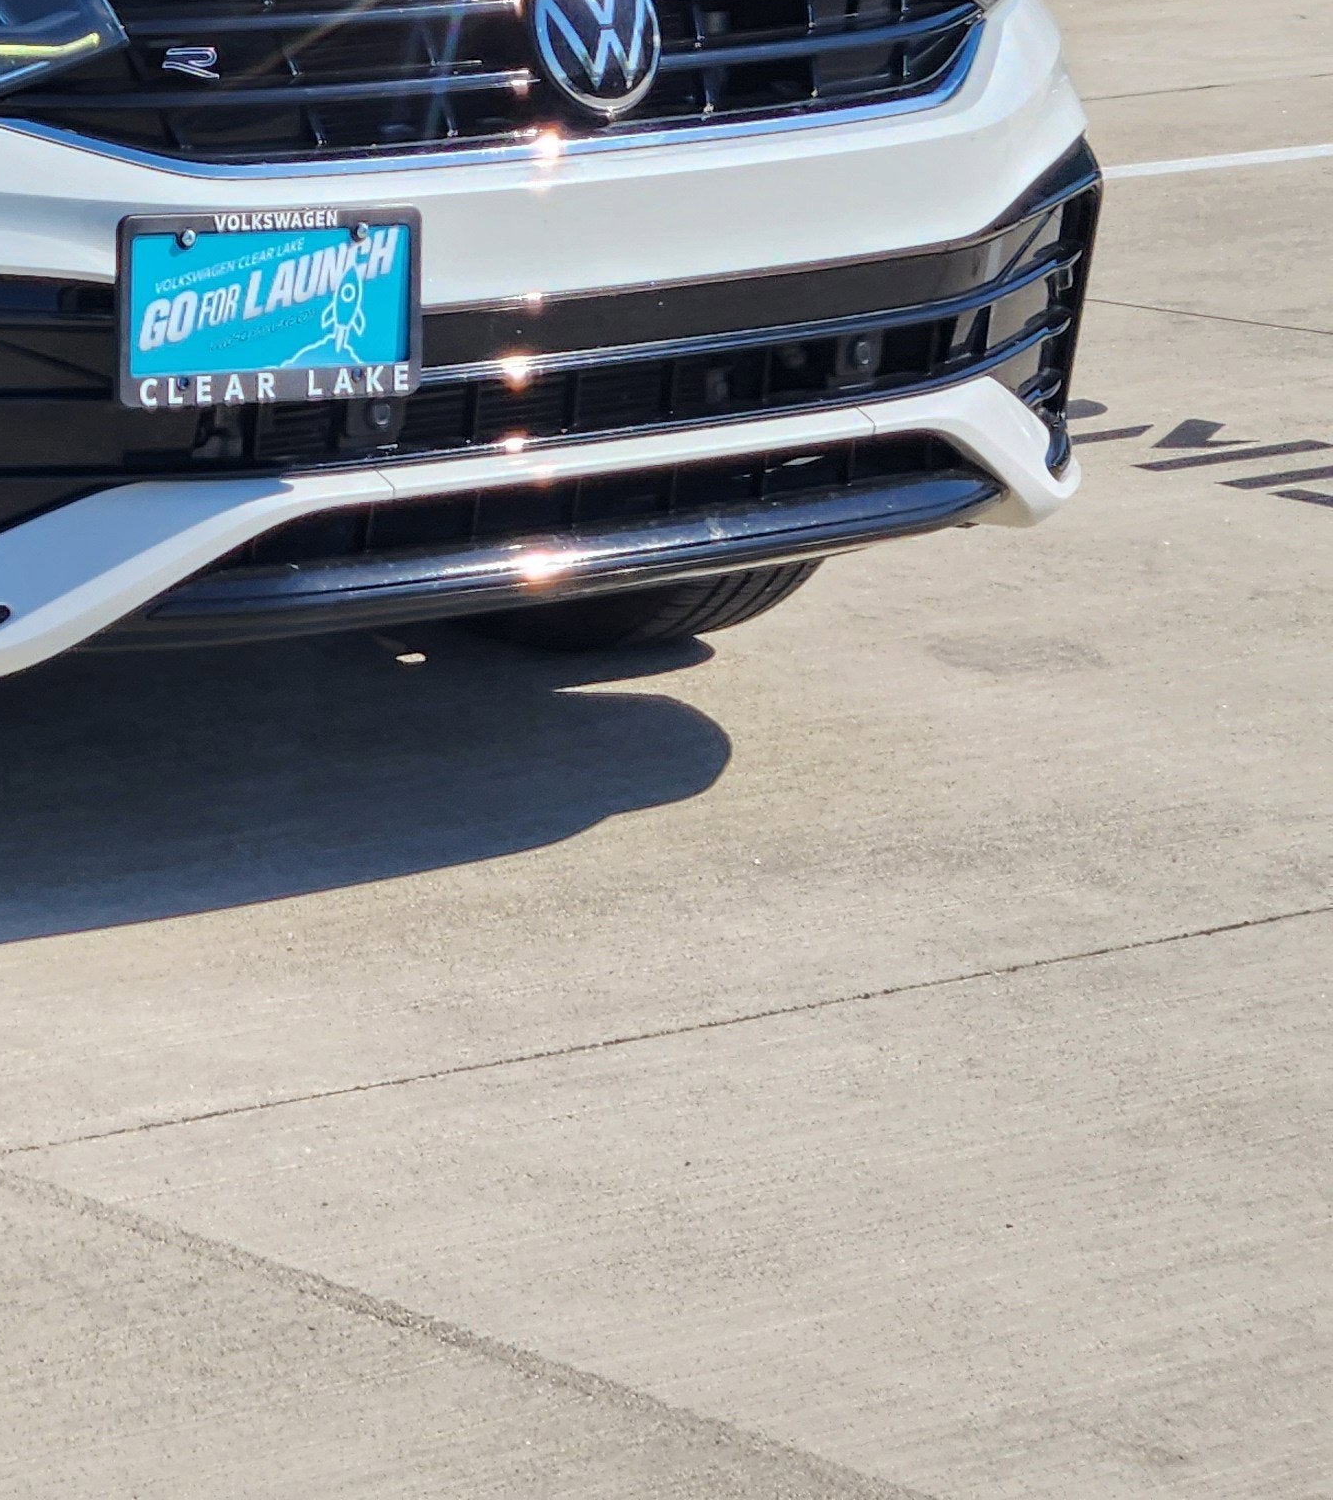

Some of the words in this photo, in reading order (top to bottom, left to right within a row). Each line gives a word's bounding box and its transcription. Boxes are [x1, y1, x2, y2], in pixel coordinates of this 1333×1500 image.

[214, 208, 339, 233] VOLKSWAGEN
[139, 290, 198, 352] GO
[197, 283, 241, 331] FOR
[242, 226, 399, 320] LAUNCH
[155, 260, 235, 294] VOLKSWAGEN
[238, 247, 275, 269] CLEAR
[276, 237, 305, 258] LAKE
[139, 372, 276, 407] CLEAR
[307, 364, 410, 398] LAKE
